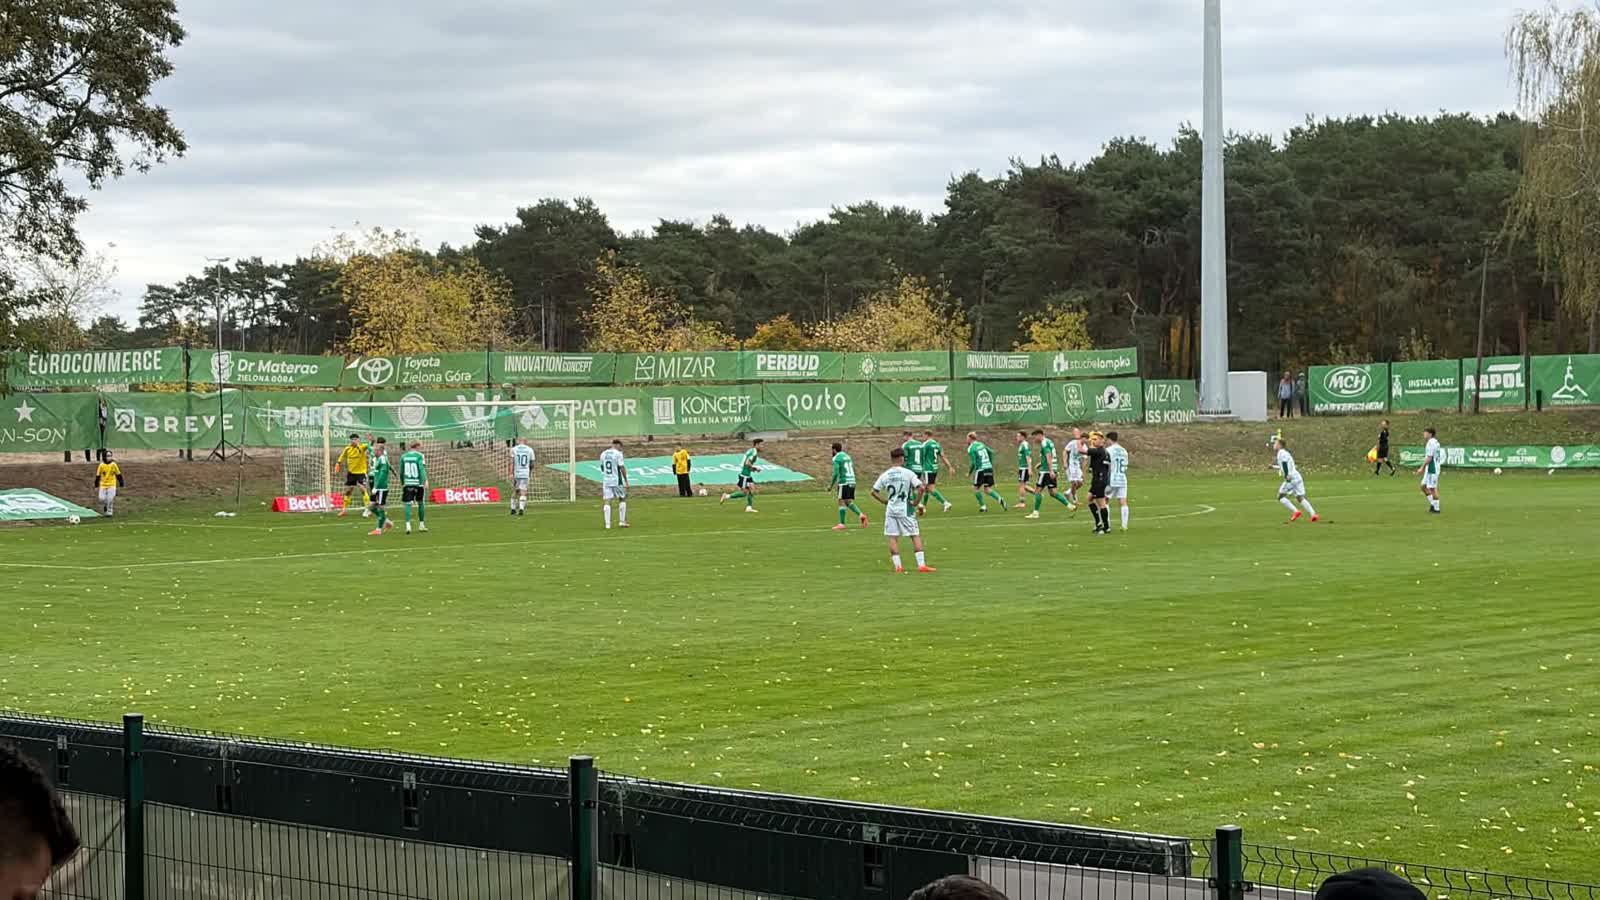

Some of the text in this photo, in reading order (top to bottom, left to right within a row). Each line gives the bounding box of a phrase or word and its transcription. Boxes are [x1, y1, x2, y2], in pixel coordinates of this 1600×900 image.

[28, 350, 162, 375] EUROCOMMERCE
[237, 359, 319, 375] Dr Materac
[404, 357, 441, 368] Toyota
[504, 355, 563, 372] INNOVATION
[658, 356, 716, 378] MIZAR
[757, 354, 819, 370] PERBUD
[237, 374, 294, 383] ZIELONA GÓRA
[402, 370, 472, 383] Zielona Góra
[1328, 371, 1367, 393] MCH
[1465, 373, 1525, 391] ARPOL
[553, 398, 637, 417] APATOR
[681, 396, 751, 415] KONCEPT
[900, 395, 952, 413] ARPOL
[144, 414, 234, 433] BREVE
[554, 419, 597, 430] RETOR
[708, 416, 720, 424] NA
[516, 454, 528, 467] 10
[604, 460, 613, 475] 9
[404, 462, 419, 478] 40
[445, 487, 490, 502] Betclic
[887, 484, 906, 501] 24
